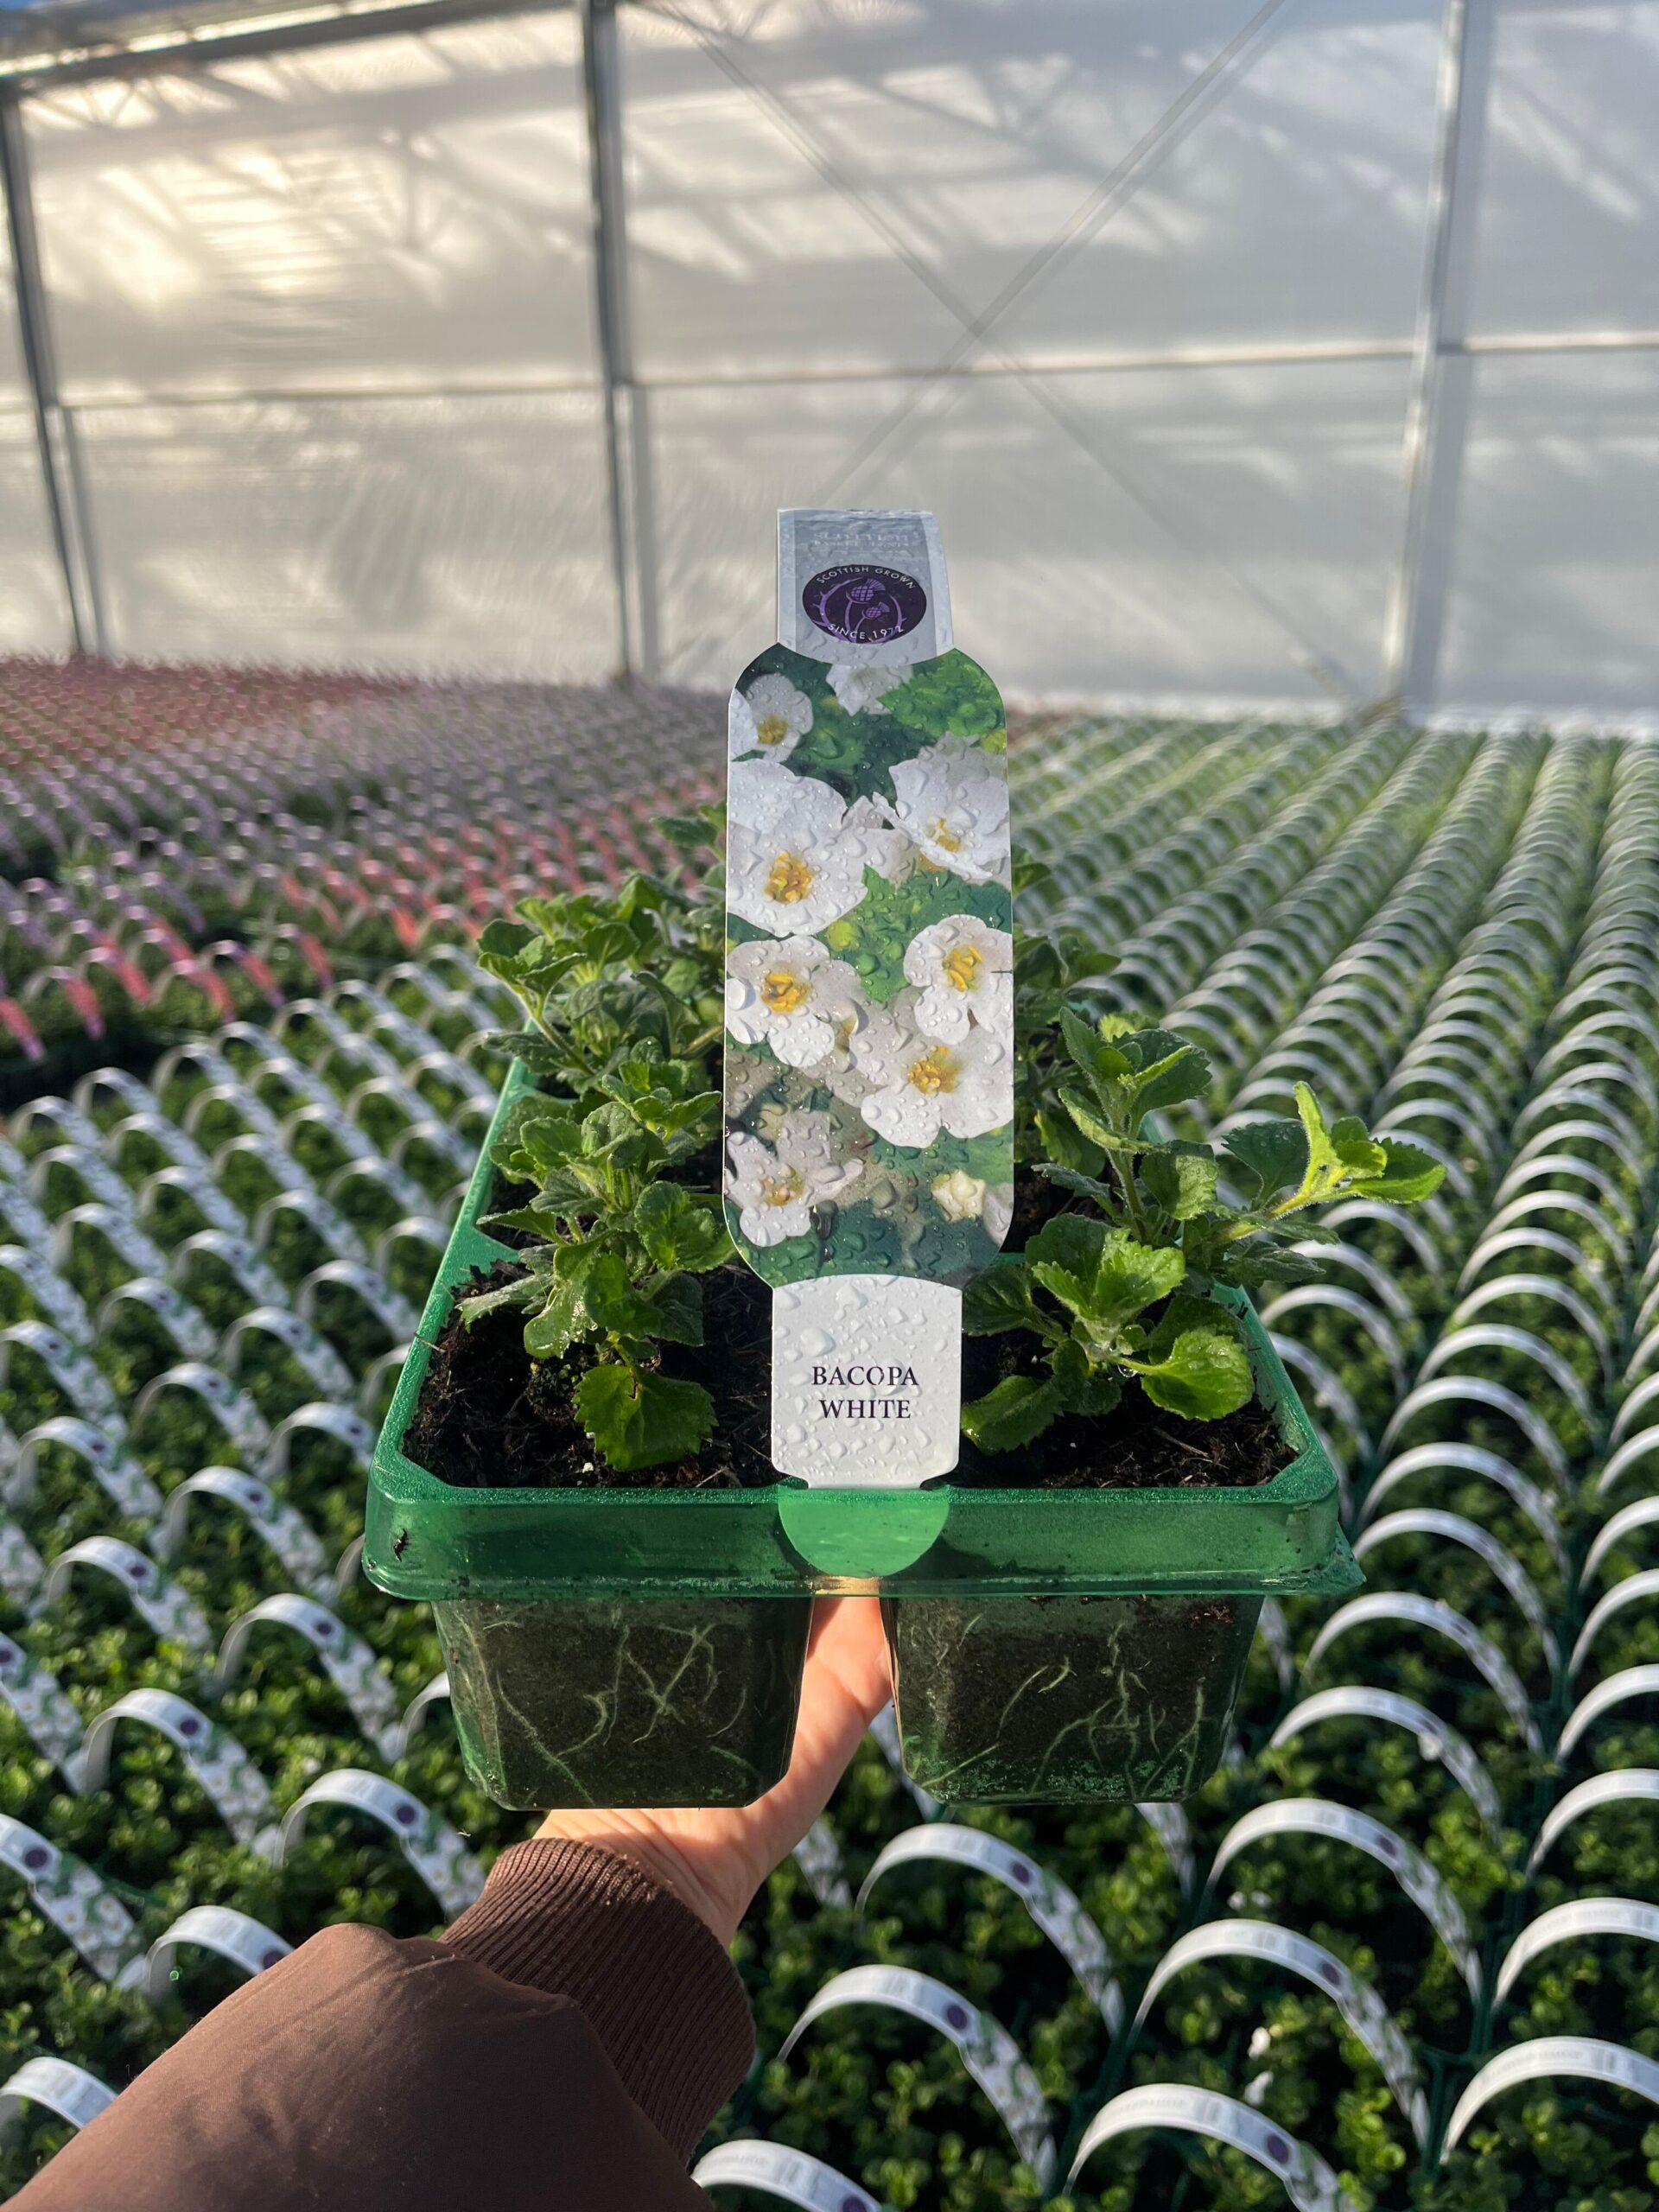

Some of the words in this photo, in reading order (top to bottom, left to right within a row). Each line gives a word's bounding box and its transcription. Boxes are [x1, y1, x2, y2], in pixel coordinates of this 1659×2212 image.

[816, 566, 869, 584] SCOTTISH
[874, 567, 916, 589] GROWN
[828, 623, 866, 639] SINCE
[811, 1365, 919, 1386] BACOPA
[818, 1399, 911, 1419] WHITE
